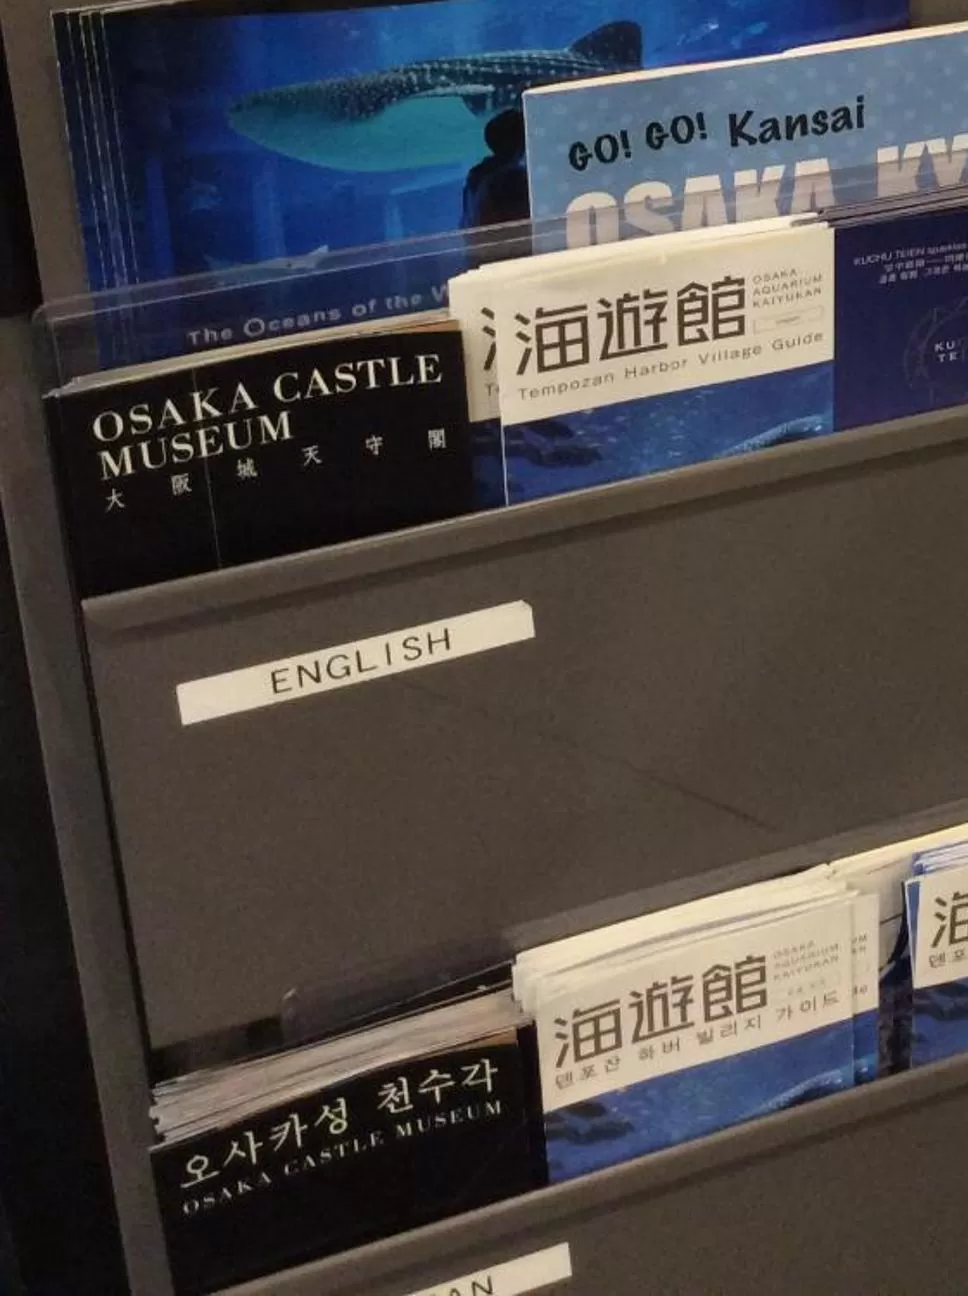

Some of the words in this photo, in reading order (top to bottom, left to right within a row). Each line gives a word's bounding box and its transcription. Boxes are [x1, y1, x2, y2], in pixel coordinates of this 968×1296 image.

[568, 129, 633, 172] GO!
[645, 111, 708, 151] GO!
[727, 94, 866, 148] Kansai
[565, 156, 837, 251] OSAKA
[752, 267, 797, 285] OSAKA
[752, 273, 823, 297] AQUARIUM
[752, 287, 822, 309] KAIYUKAN
[187, 327, 233, 346] The
[243, 307, 342, 338] Oceans
[351, 298, 377, 318] of
[385, 293, 422, 312] the
[514, 274, 746, 377] 海遊館
[92, 380, 259, 444] OSAKA
[272, 353, 443, 404] CASTLE
[518, 370, 615, 402] Tempozan
[624, 357, 688, 379] Harbor
[698, 344, 762, 366] Village
[771, 331, 824, 351] Guide
[98, 410, 296, 482] MUSEUM
[270, 627, 452, 695] ENGLISH
[553, 954, 768, 1069] 海遊館
[775, 989, 840, 1021] 가이드
[179, 1096, 350, 1190] 오사카성
[375, 1057, 500, 1114] 천수각
[181, 1171, 273, 1215] OSAKA
[283, 1130, 385, 1178] CASTLE
[395, 1099, 503, 1139] MUSEUM
